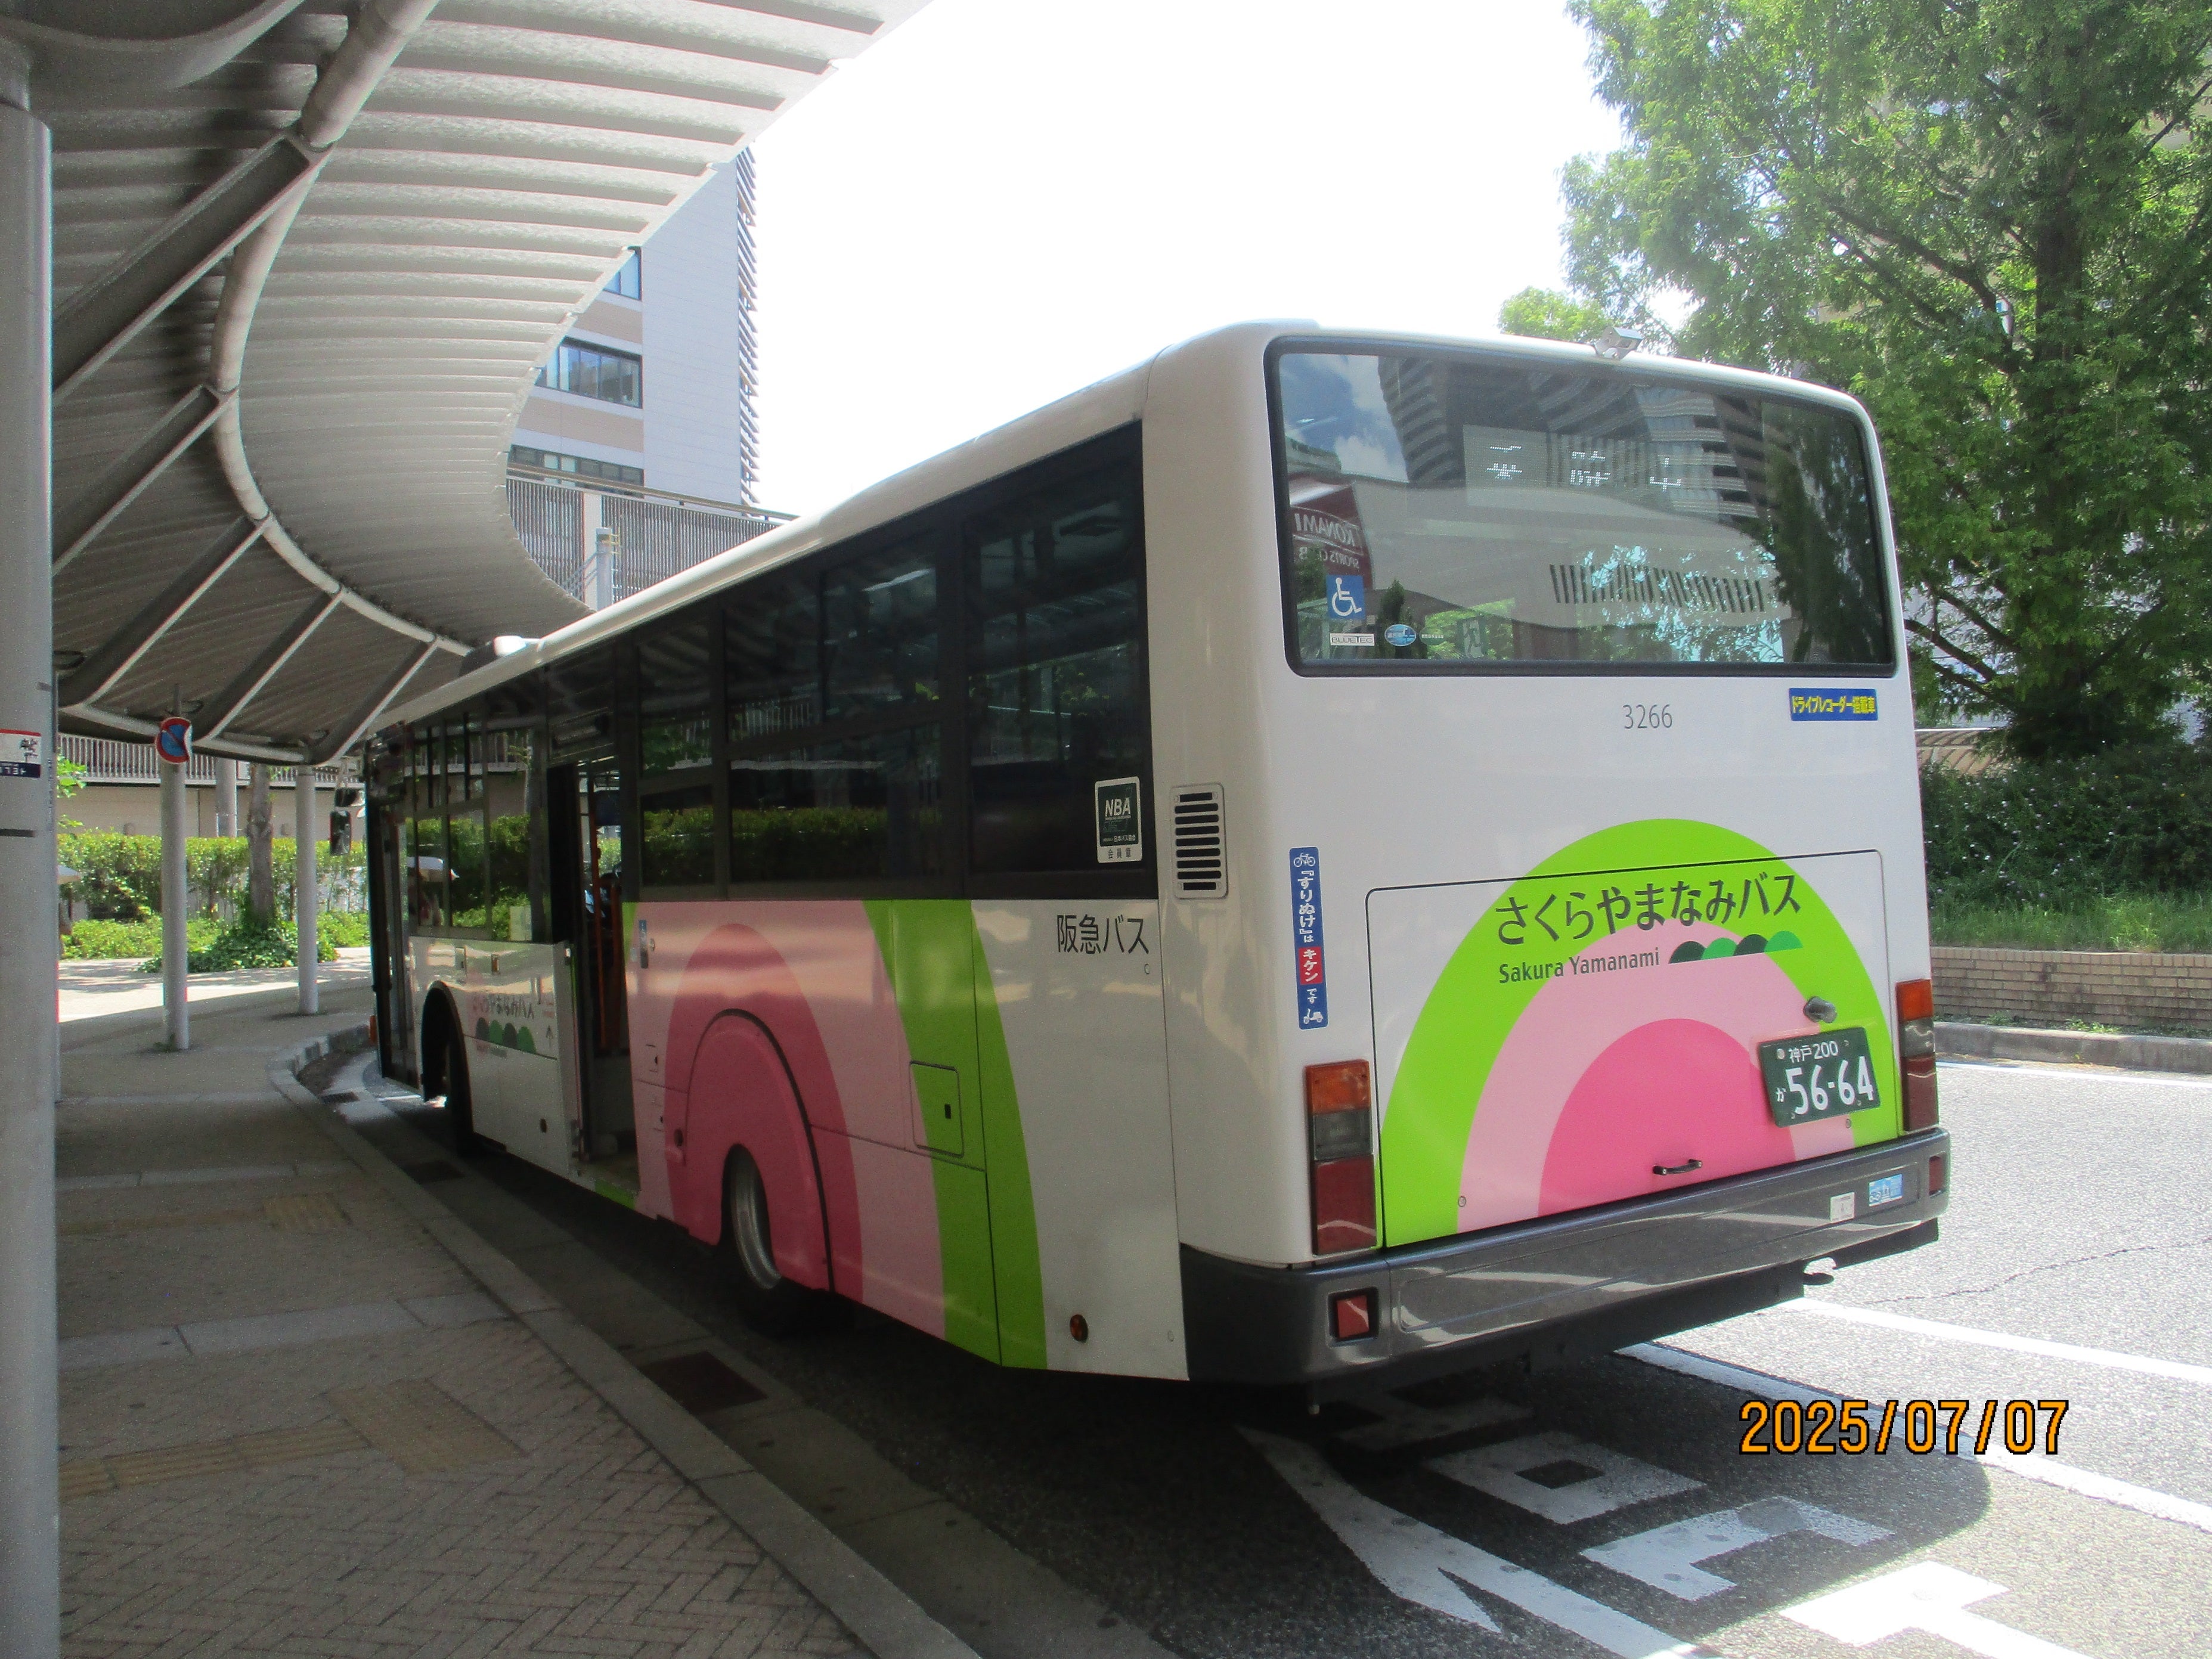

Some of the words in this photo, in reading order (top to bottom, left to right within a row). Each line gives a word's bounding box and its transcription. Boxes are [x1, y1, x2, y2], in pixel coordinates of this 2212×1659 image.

[1331, 635, 1373, 643] BLUETEC
[1624, 704, 1672, 730] 3266
[1105, 798, 1131, 817] NBA
[1495, 871, 1801, 945] さくらやまなみバス
[1057, 914, 1149, 954] 阪急バス
[1499, 960, 1564, 984] Sakura
[1569, 947, 1660, 976] Yamanami
[1776, 1087, 1786, 1103] か
[1786, 1056, 1875, 1115] 56-64
